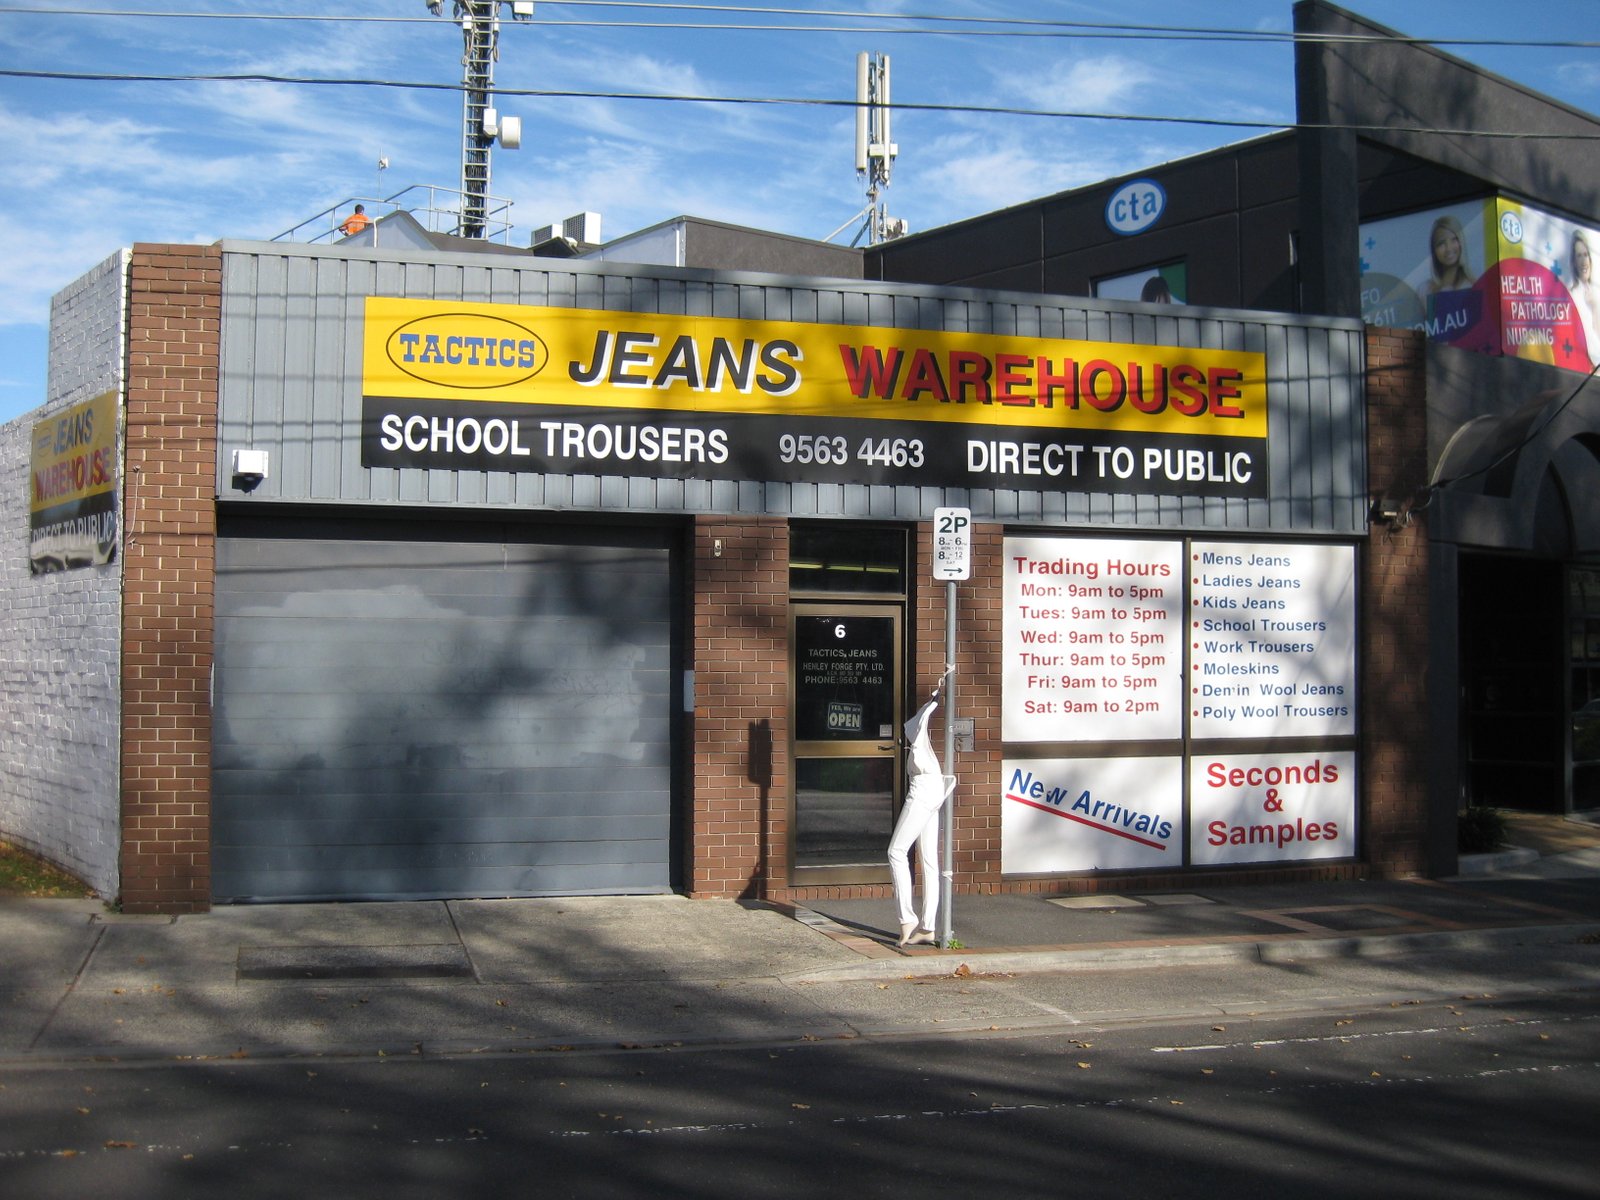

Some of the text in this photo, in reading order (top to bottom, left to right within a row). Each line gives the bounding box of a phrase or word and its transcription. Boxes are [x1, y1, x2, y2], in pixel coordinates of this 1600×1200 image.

[1114, 191, 1157, 222] cta
[1502, 217, 1521, 237] cta
[1501, 275, 1543, 295] HEALTH
[1511, 301, 1571, 321] PATHOLOGY
[1506, 327, 1554, 345] NURSING
[400, 333, 535, 368] TACTICS
[568, 329, 1245, 419] JEANS WAREHOUSE
[53, 408, 94, 455] JEANS
[380, 414, 1253, 484] SCHOOL TROUSERS 9563 4463 DIRECT TO PUBLIC
[35, 447, 112, 502] WAREHOUSE
[78, 510, 113, 546] PUBLIC
[938, 516, 968, 534] 2P
[1013, 556, 1171, 580] Trading Hours
[1202, 552, 1291, 567] Mens Jeans
[1202, 574, 1301, 589] Ladies Jeans
[1021, 583, 1164, 600] Mon: 9am to 5pm
[1202, 595, 1286, 609] Kids Jeans
[1019, 605, 1167, 622] Tues: 9am to 5pm
[834, 624, 846, 639] 6
[1203, 619, 1326, 632] School Trousers
[1020, 630, 1164, 647] Wed: 9am to 5pm
[1204, 640, 1314, 653] Work Trousers
[808, 648, 878, 658] TACTICS JEANS
[1019, 652, 1165, 669] Thur: 9am to 5pm
[1203, 662, 1280, 675] Moleskins
[862, 676, 883, 685] 4463
[1028, 675, 1157, 691] Fri: 9am to 5pm
[1260, 683, 1297, 696] Wool
[1301, 683, 1344, 696] Jeans
[1024, 699, 1159, 715] Sat: 9am to 2pm
[1202, 704, 1348, 721] Poly Wool Trousers
[829, 712, 860, 727] OPEN
[1207, 760, 1339, 788] Seconds
[1009, 768, 1172, 840] New Arrivals
[1263, 788, 1285, 813] &
[1207, 817, 1339, 849] Samples
